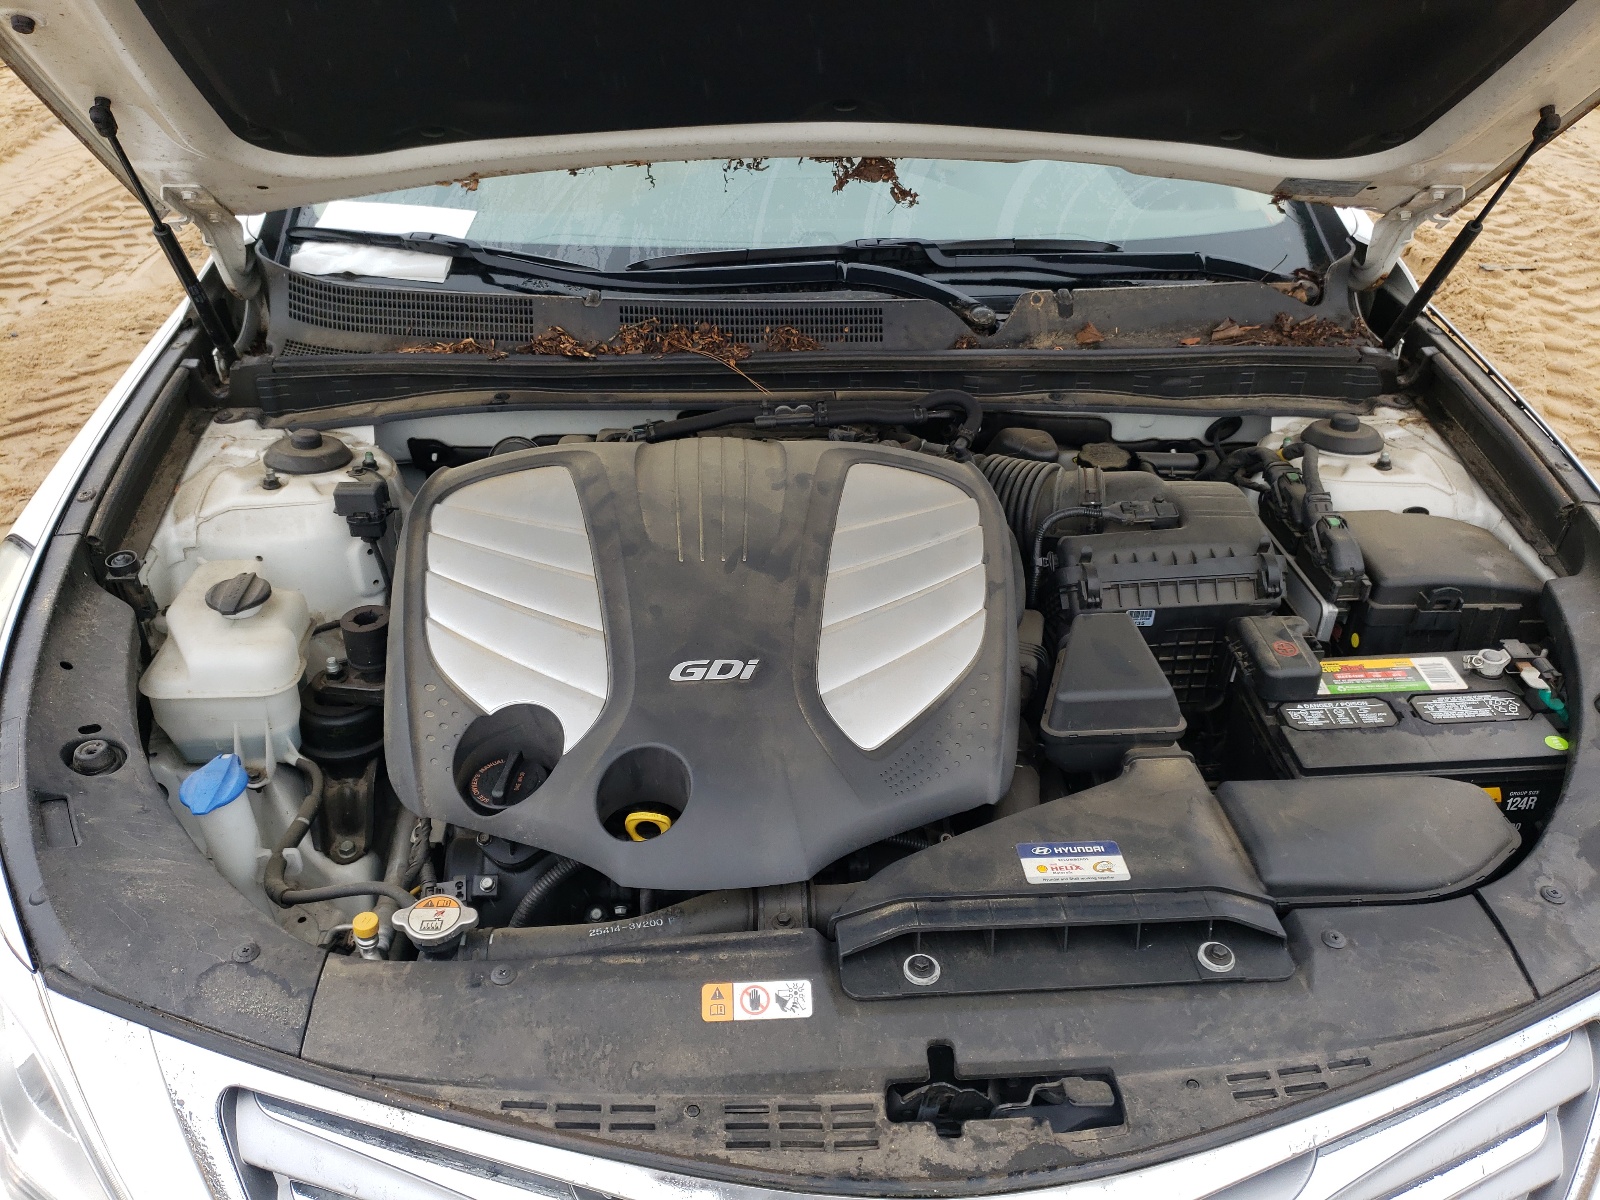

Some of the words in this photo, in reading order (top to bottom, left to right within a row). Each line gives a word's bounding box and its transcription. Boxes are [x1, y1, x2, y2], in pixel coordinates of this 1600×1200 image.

[668, 659, 760, 681] GDi
[1506, 796, 1537, 811] 124R
[1053, 845, 1105, 854] HYUNDAI
[588, 918, 664, 937] 25414-3V200
